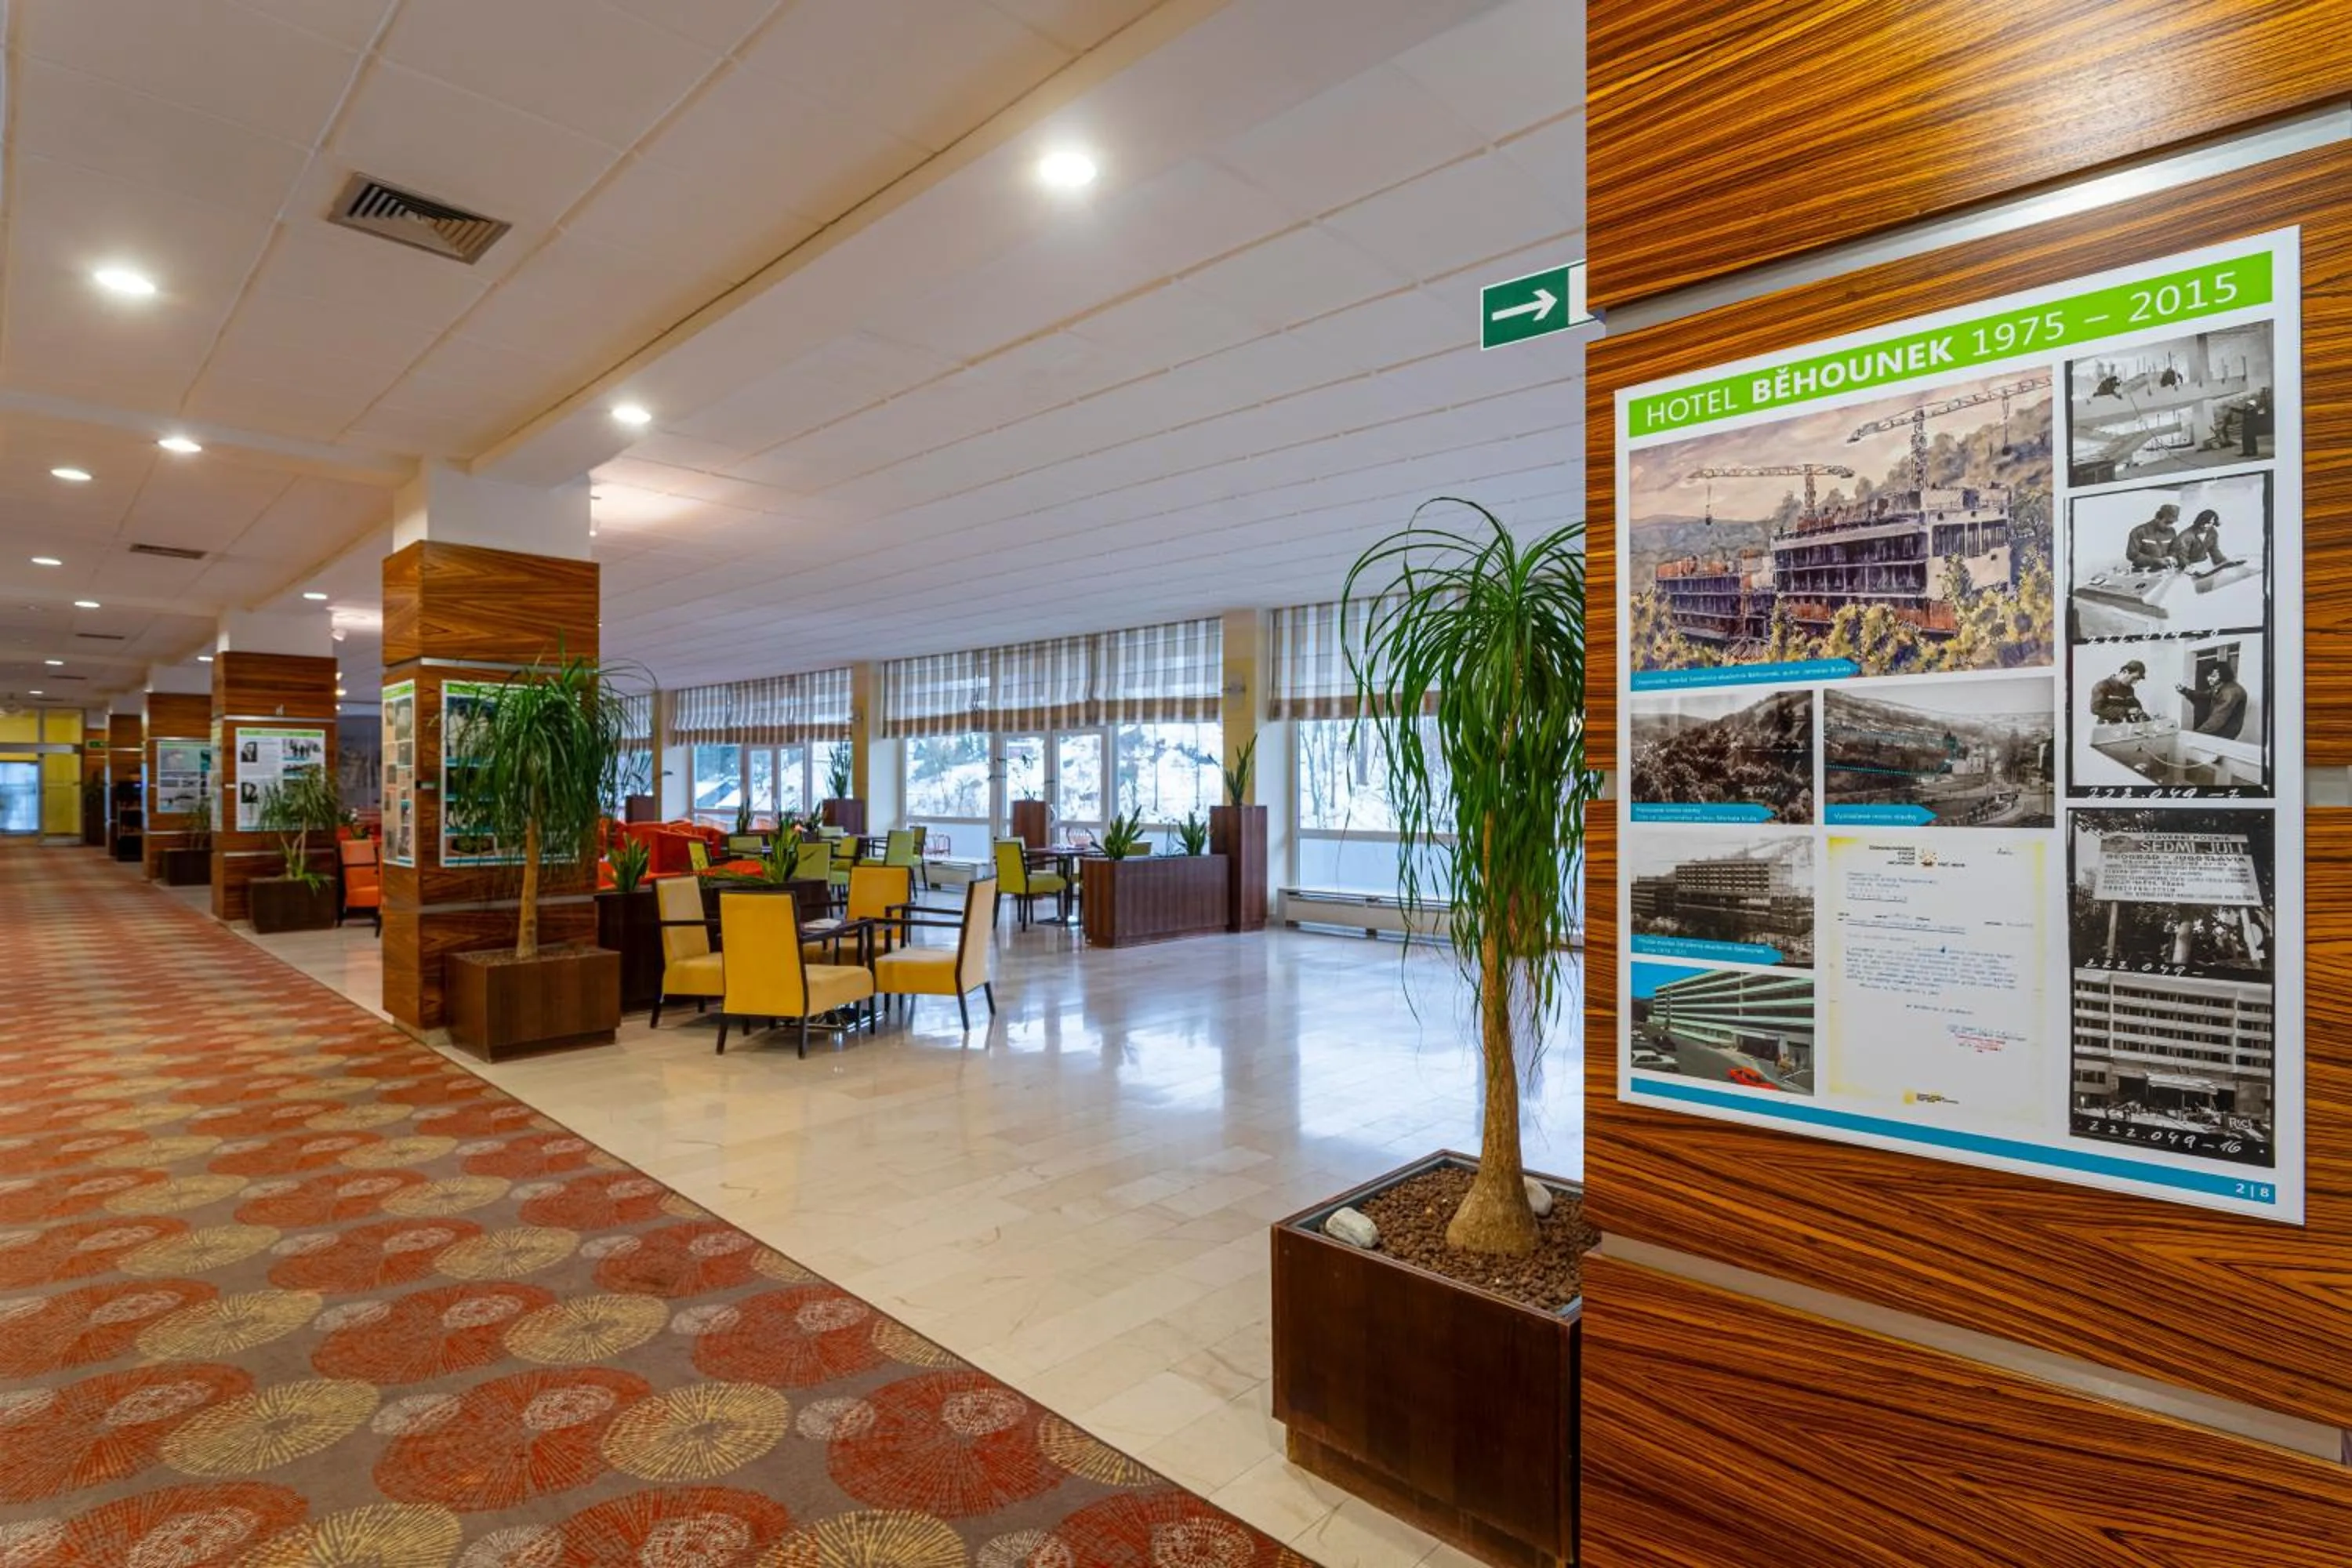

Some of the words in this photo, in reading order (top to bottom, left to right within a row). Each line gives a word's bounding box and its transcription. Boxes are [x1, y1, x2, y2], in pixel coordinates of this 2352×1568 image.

[1646, 387, 1739, 428] HOTEL
[1751, 335, 1955, 405] BĚHOUNEK
[1972, 310, 2066, 358] 1975
[2128, 271, 2238, 323] 2015
[2140, 840, 2196, 854] SEDMI
[2235, 1183, 2245, 1194] 2
[2259, 1187, 2270, 1198] 8
